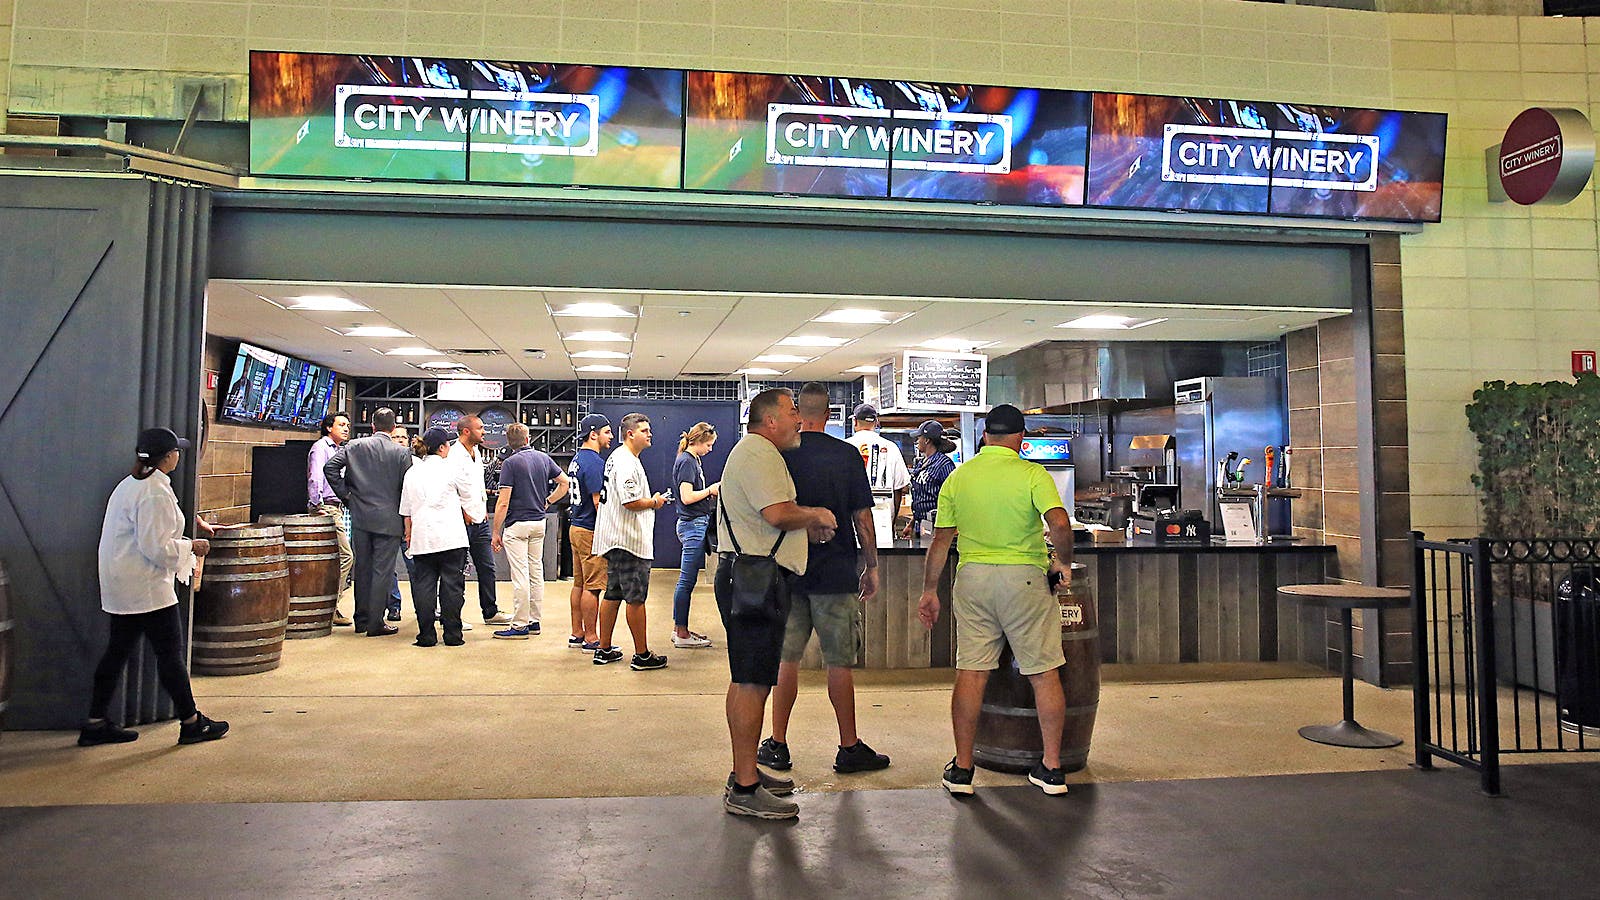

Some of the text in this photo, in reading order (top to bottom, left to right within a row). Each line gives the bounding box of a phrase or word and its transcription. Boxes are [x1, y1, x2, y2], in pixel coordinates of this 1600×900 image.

[353, 104, 580, 138] CITY WINERY
[784, 122, 994, 156] CITY WINERY
[1178, 142, 1363, 174] CITY WINERY
[1504, 143, 1556, 169] CITY WINERY
[1035, 443, 1070, 456] pepsi
[1061, 609, 1079, 618] ERY
